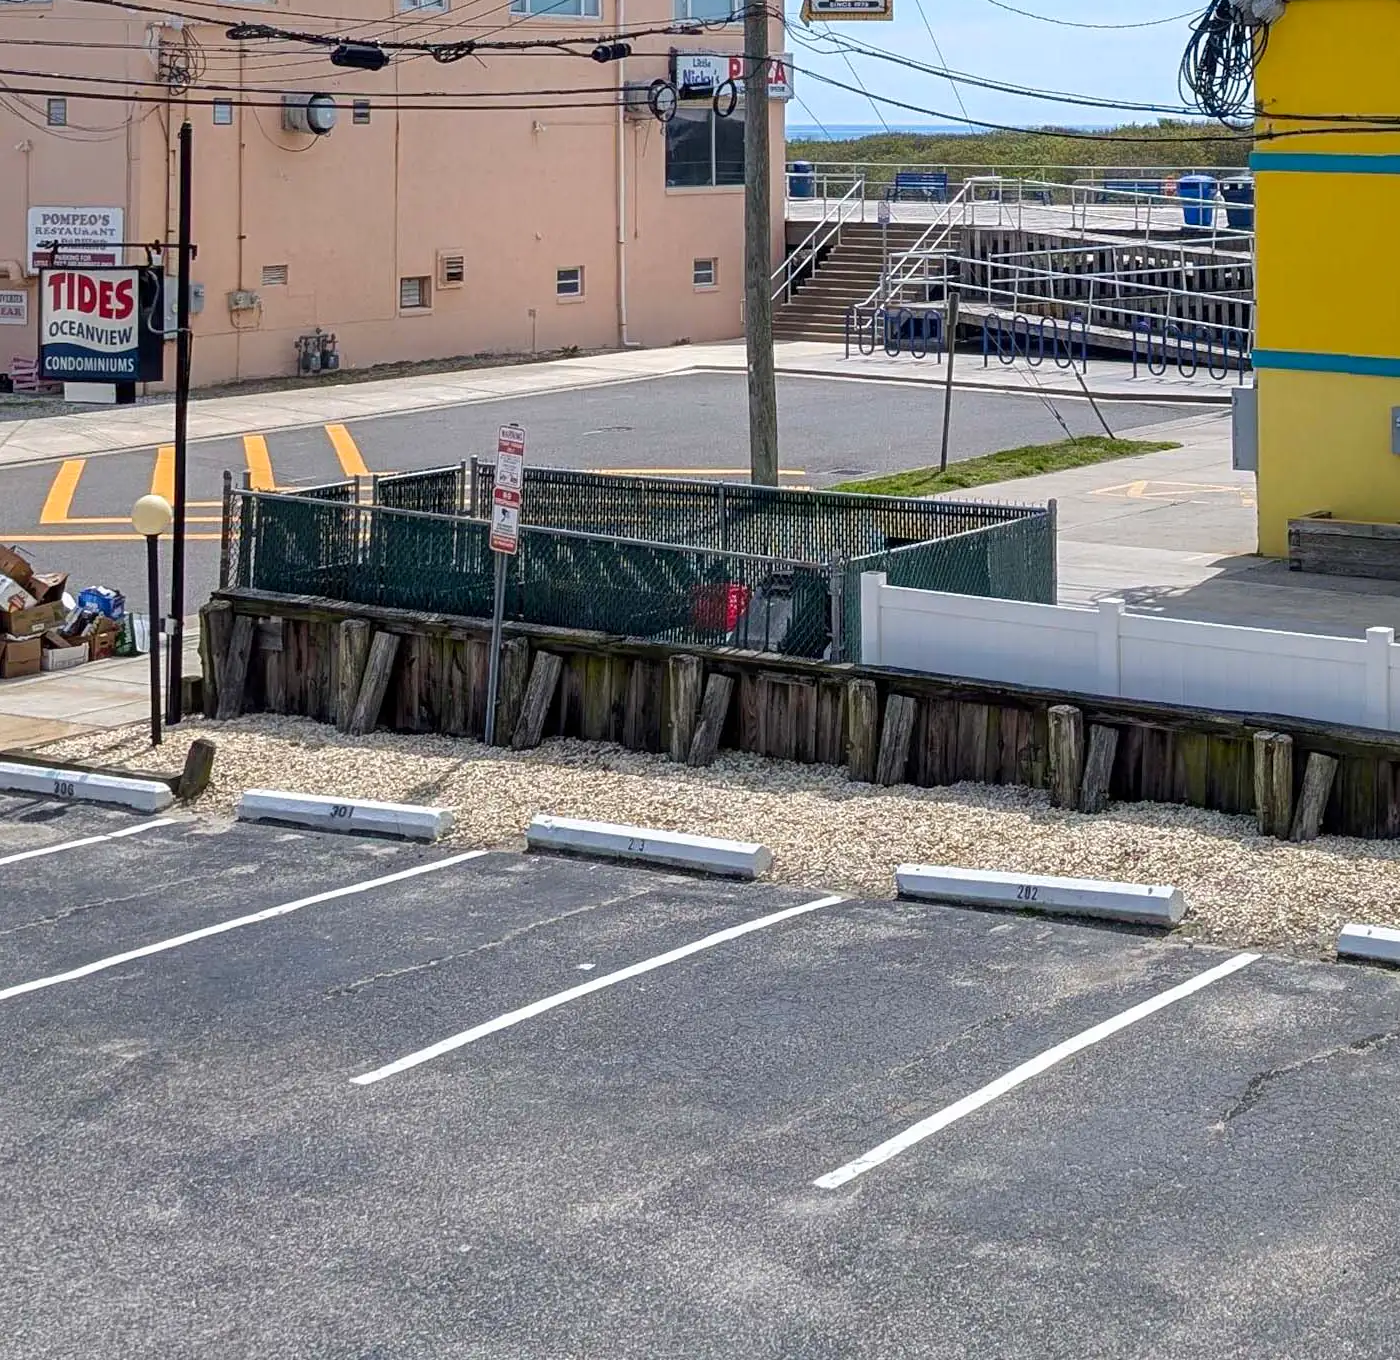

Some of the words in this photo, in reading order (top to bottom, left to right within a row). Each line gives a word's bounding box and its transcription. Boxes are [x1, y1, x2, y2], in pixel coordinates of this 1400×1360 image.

[683, 69, 720, 86] Nicky's
[41, 213, 111, 227] POMPEO'S
[35, 227, 116, 236] RESTAURANT
[47, 272, 134, 320] TIDES
[48, 320, 133, 346] OCEANVIEW
[44, 355, 135, 373] CONDOMINIUMS
[331, 805, 355, 818] 301
[1017, 885, 1038, 900] 202
